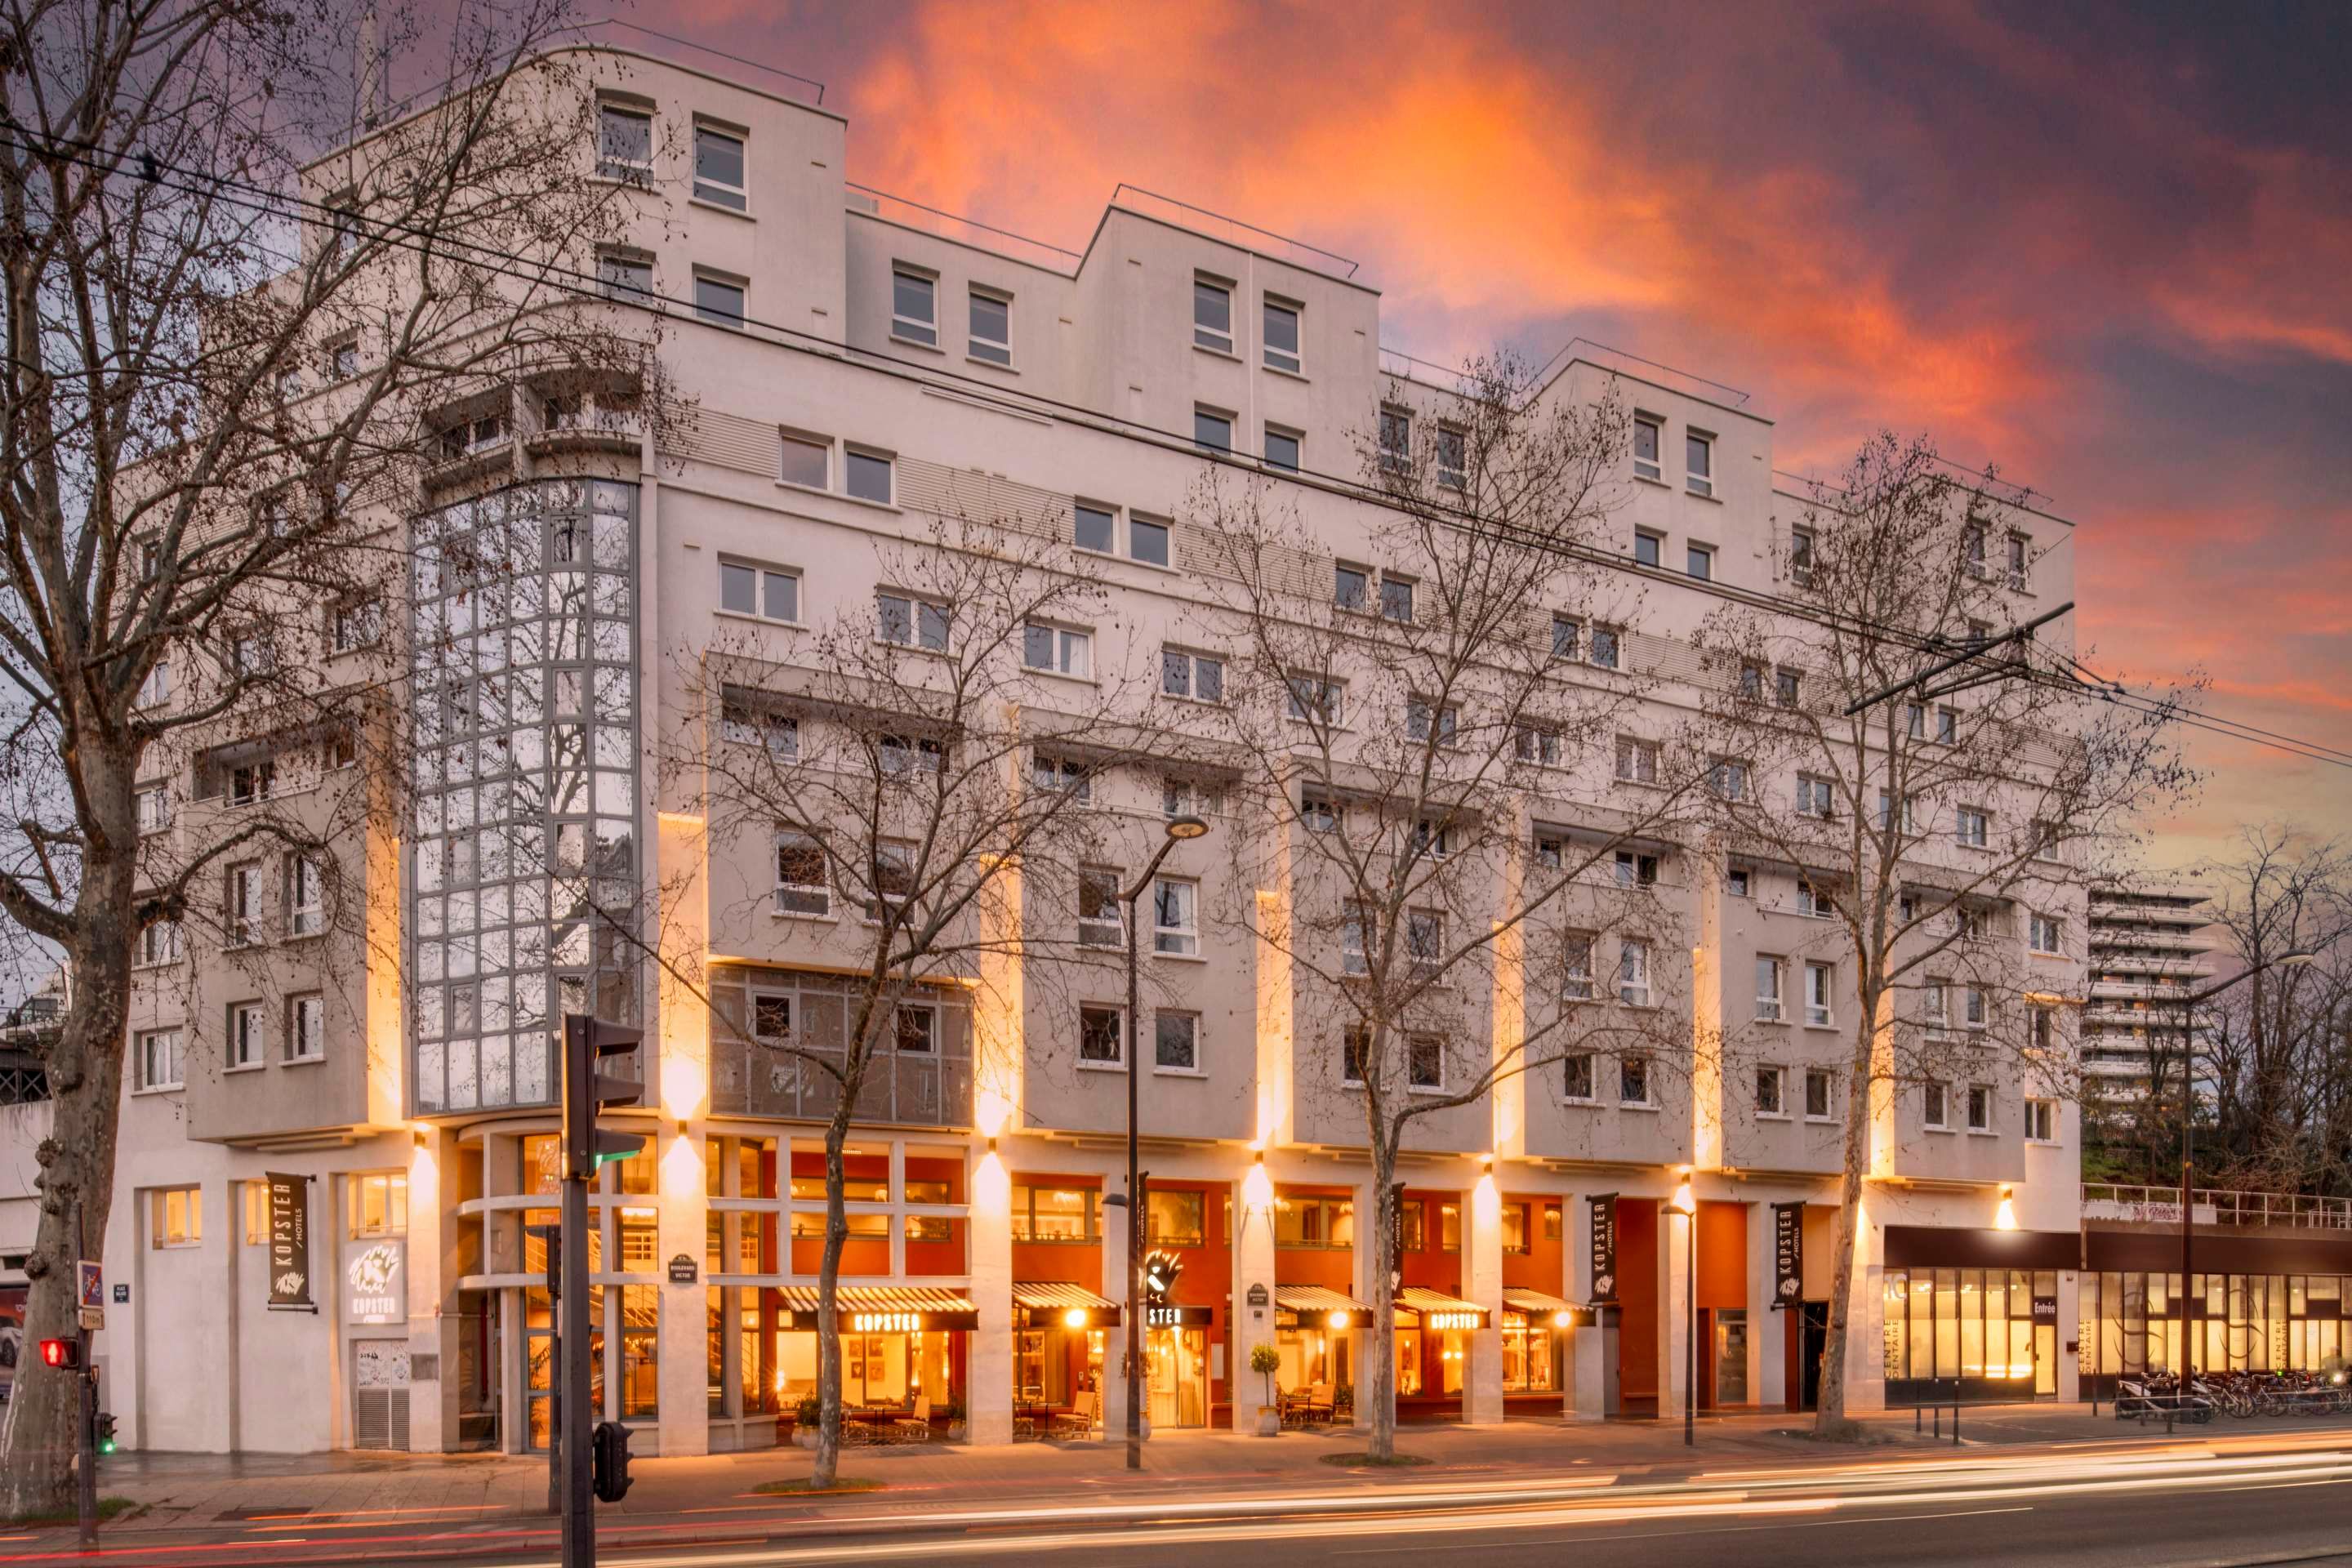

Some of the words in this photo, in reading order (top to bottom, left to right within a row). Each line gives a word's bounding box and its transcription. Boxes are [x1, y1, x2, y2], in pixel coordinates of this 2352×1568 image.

[274, 1184, 292, 1266] KOPSTER
[1594, 1203, 1606, 1272] KOPSTER
[1780, 1211, 1792, 1275] KOPSTER
[353, 1297, 395, 1314] KOPSTER
[2034, 1302, 2056, 1314] Entrée
[854, 1312, 920, 1331] KOPSTER
[1149, 1308, 1181, 1325] STER
[1431, 1313, 1479, 1330] KOPSTER
[1883, 1319, 1891, 1379] CENTRE
